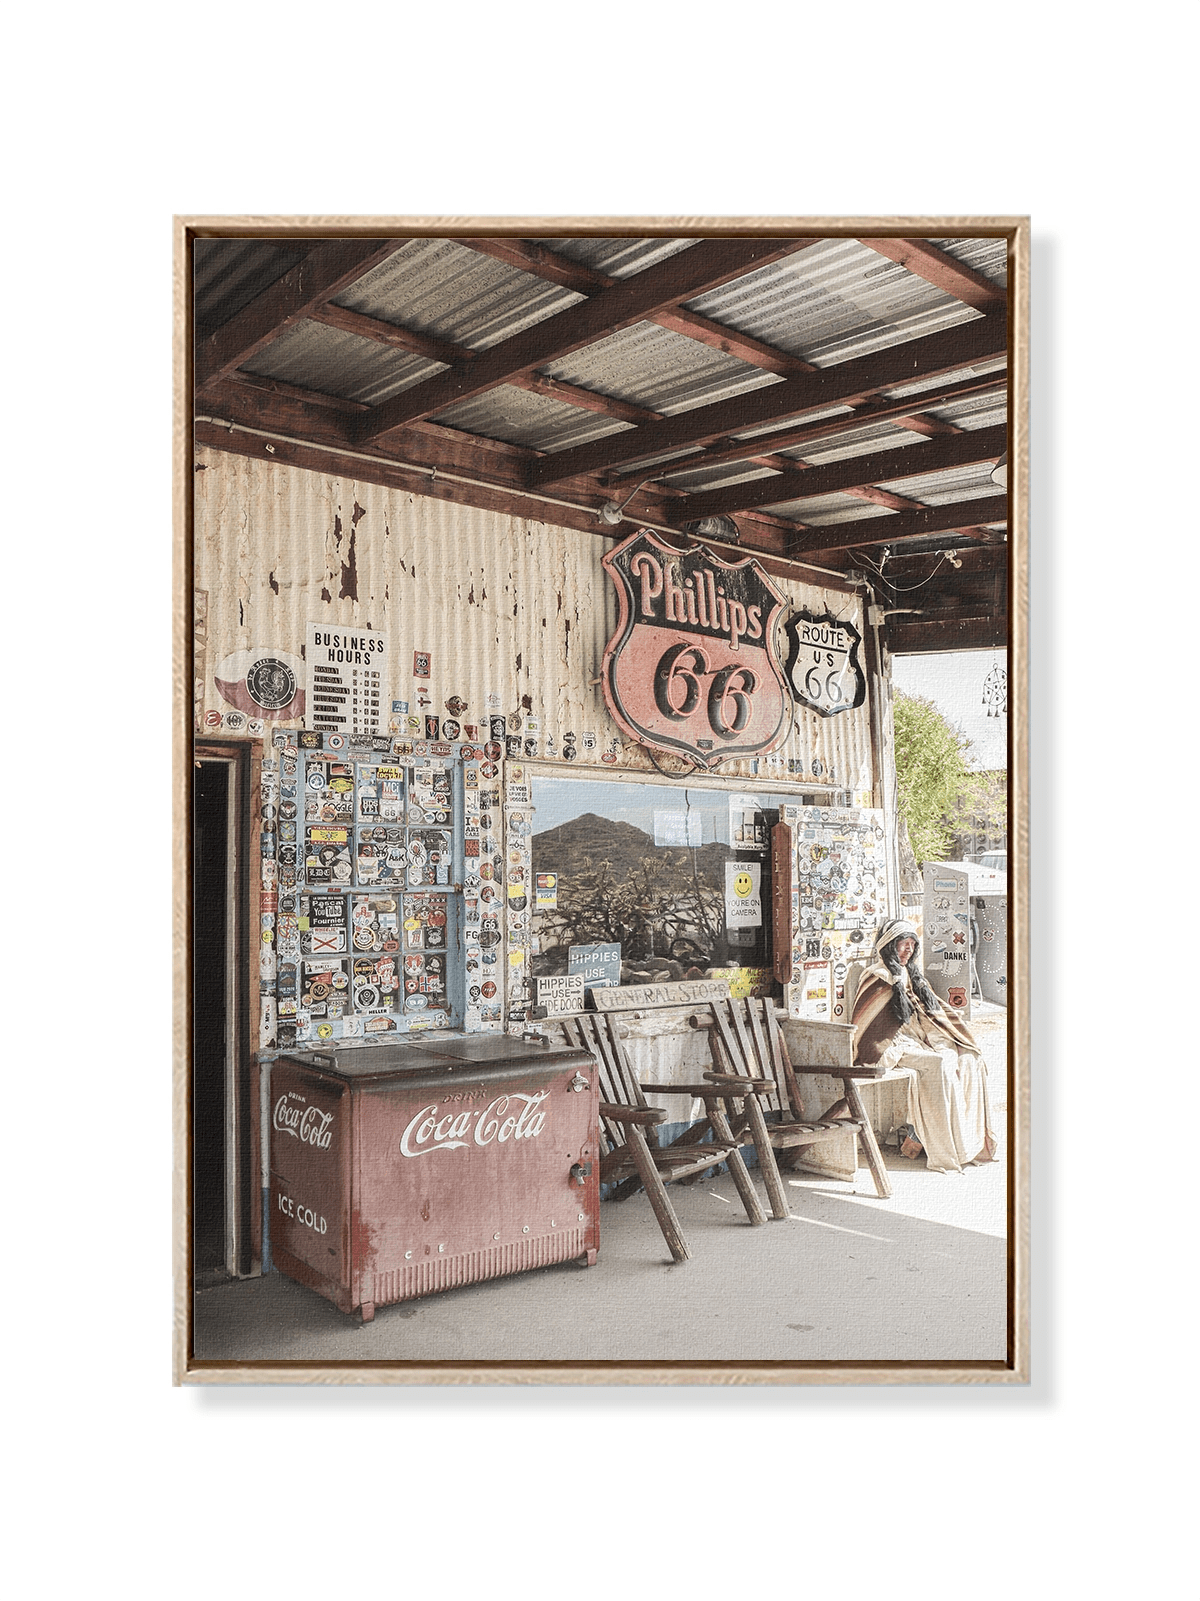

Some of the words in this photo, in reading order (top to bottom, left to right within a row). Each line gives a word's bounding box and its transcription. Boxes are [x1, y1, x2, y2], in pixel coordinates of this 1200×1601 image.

[630, 551, 762, 651] Phillips
[315, 632, 384, 653] BUSINESS
[802, 625, 844, 648] ROUTE
[328, 648, 371, 665] HOURS
[654, 643, 762, 740] 66
[805, 666, 843, 704] 66
[731, 908, 757, 917] CAMERA
[484, 920, 496, 929] 66
[571, 951, 619, 964] HIPPIES
[944, 952, 967, 960] DANKE
[585, 968, 605, 978] USE
[539, 976, 582, 990] HIPPIES
[551, 989, 570, 999] USE
[599, 986, 677, 1009] GENERAL
[678, 983, 728, 1003] STORE
[560, 997, 583, 1011] DOOR
[288, 1092, 306, 1103] DRINK
[442, 1089, 488, 1104] DRINK
[278, 1193, 294, 1218] ICE
[296, 1204, 327, 1234] COLD
